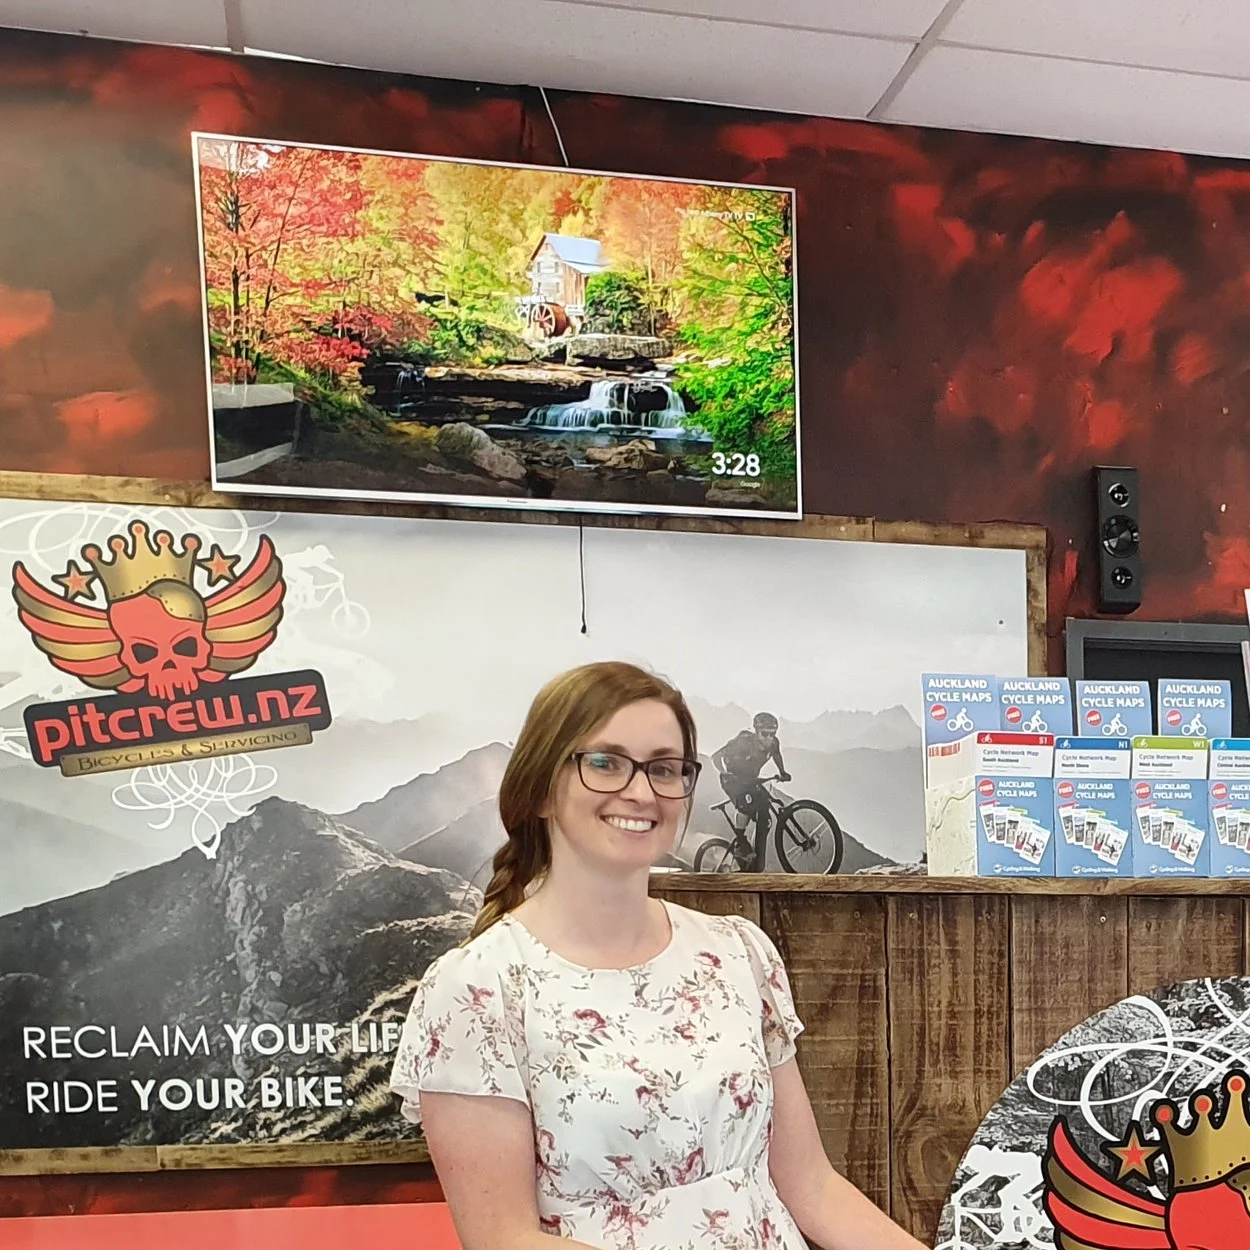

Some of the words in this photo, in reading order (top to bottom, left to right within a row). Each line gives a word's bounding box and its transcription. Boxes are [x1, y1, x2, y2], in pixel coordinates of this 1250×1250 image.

[711, 452, 761, 477] 3:28
[928, 679, 987, 689] AUCKLAND
[1003, 682, 1060, 691] AUCKLAND
[1084, 686, 1140, 694] AUCKLAND
[1165, 685, 1222, 694] AUCKLAND
[926, 692, 960, 702] CYCLE
[962, 693, 992, 702] MAPS
[1002, 695, 1035, 704] CYCLE
[1037, 695, 1065, 704] MAPS
[1082, 698, 1114, 707] CYCLE
[1116, 698, 1144, 707] MAPS
[1163, 698, 1195, 707] CYCLE
[1197, 699, 1225, 708] MAPS
[33, 685, 321, 762] pitcrew.nz
[1038, 736, 1048, 744] S1
[1192, 740, 1205, 748] W1
[79, 749, 175, 772] BICYCLES
[182, 744, 193, 757] &
[200, 731, 297, 754] SERVICING
[23, 1026, 211, 1060] RECLAIM
[224, 1024, 338, 1056] YOUR
[352, 1022, 398, 1053] LIF
[26, 1080, 119, 1114] RIDE
[131, 1079, 247, 1111] YOUR
[261, 1076, 355, 1109] BIKE.
